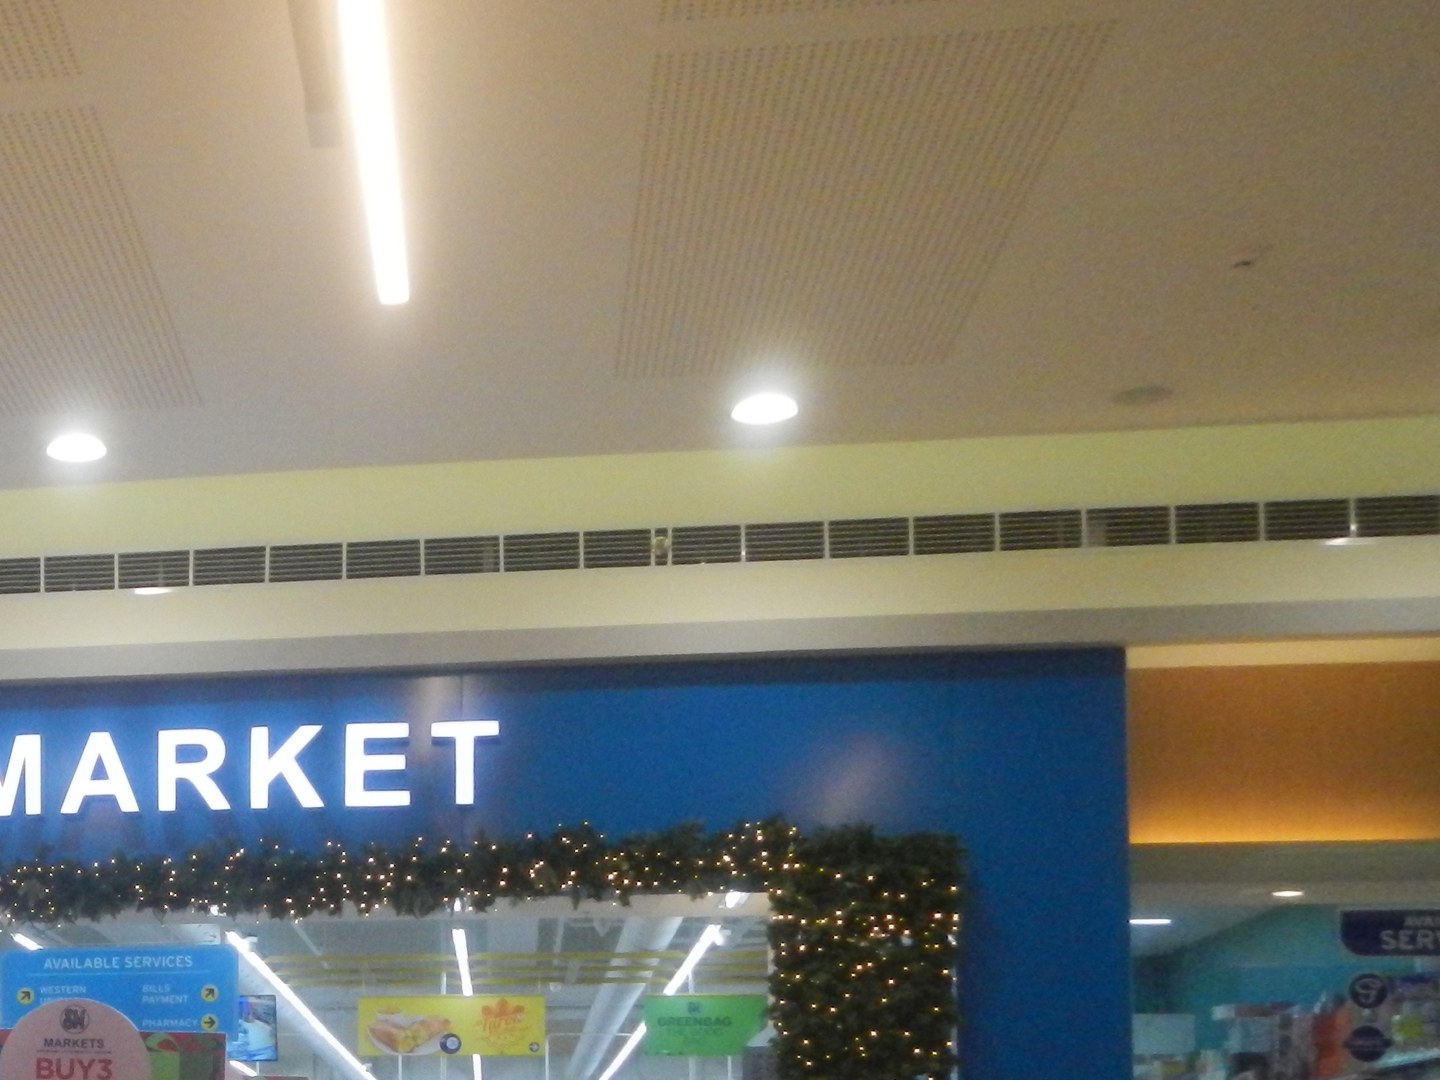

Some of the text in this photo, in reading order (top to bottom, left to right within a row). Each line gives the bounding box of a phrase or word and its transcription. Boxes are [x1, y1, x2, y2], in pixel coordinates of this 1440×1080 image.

[43, 955, 193, 970] AVAILABLE SERVICES
[39, 985, 87, 995] WESTERN
[142, 984, 171, 993] BILLS
[142, 994, 189, 1005] PAYMENT
[142, 1018, 198, 1028] PHARMACY
[43, 1037, 105, 1049] MARKETS
